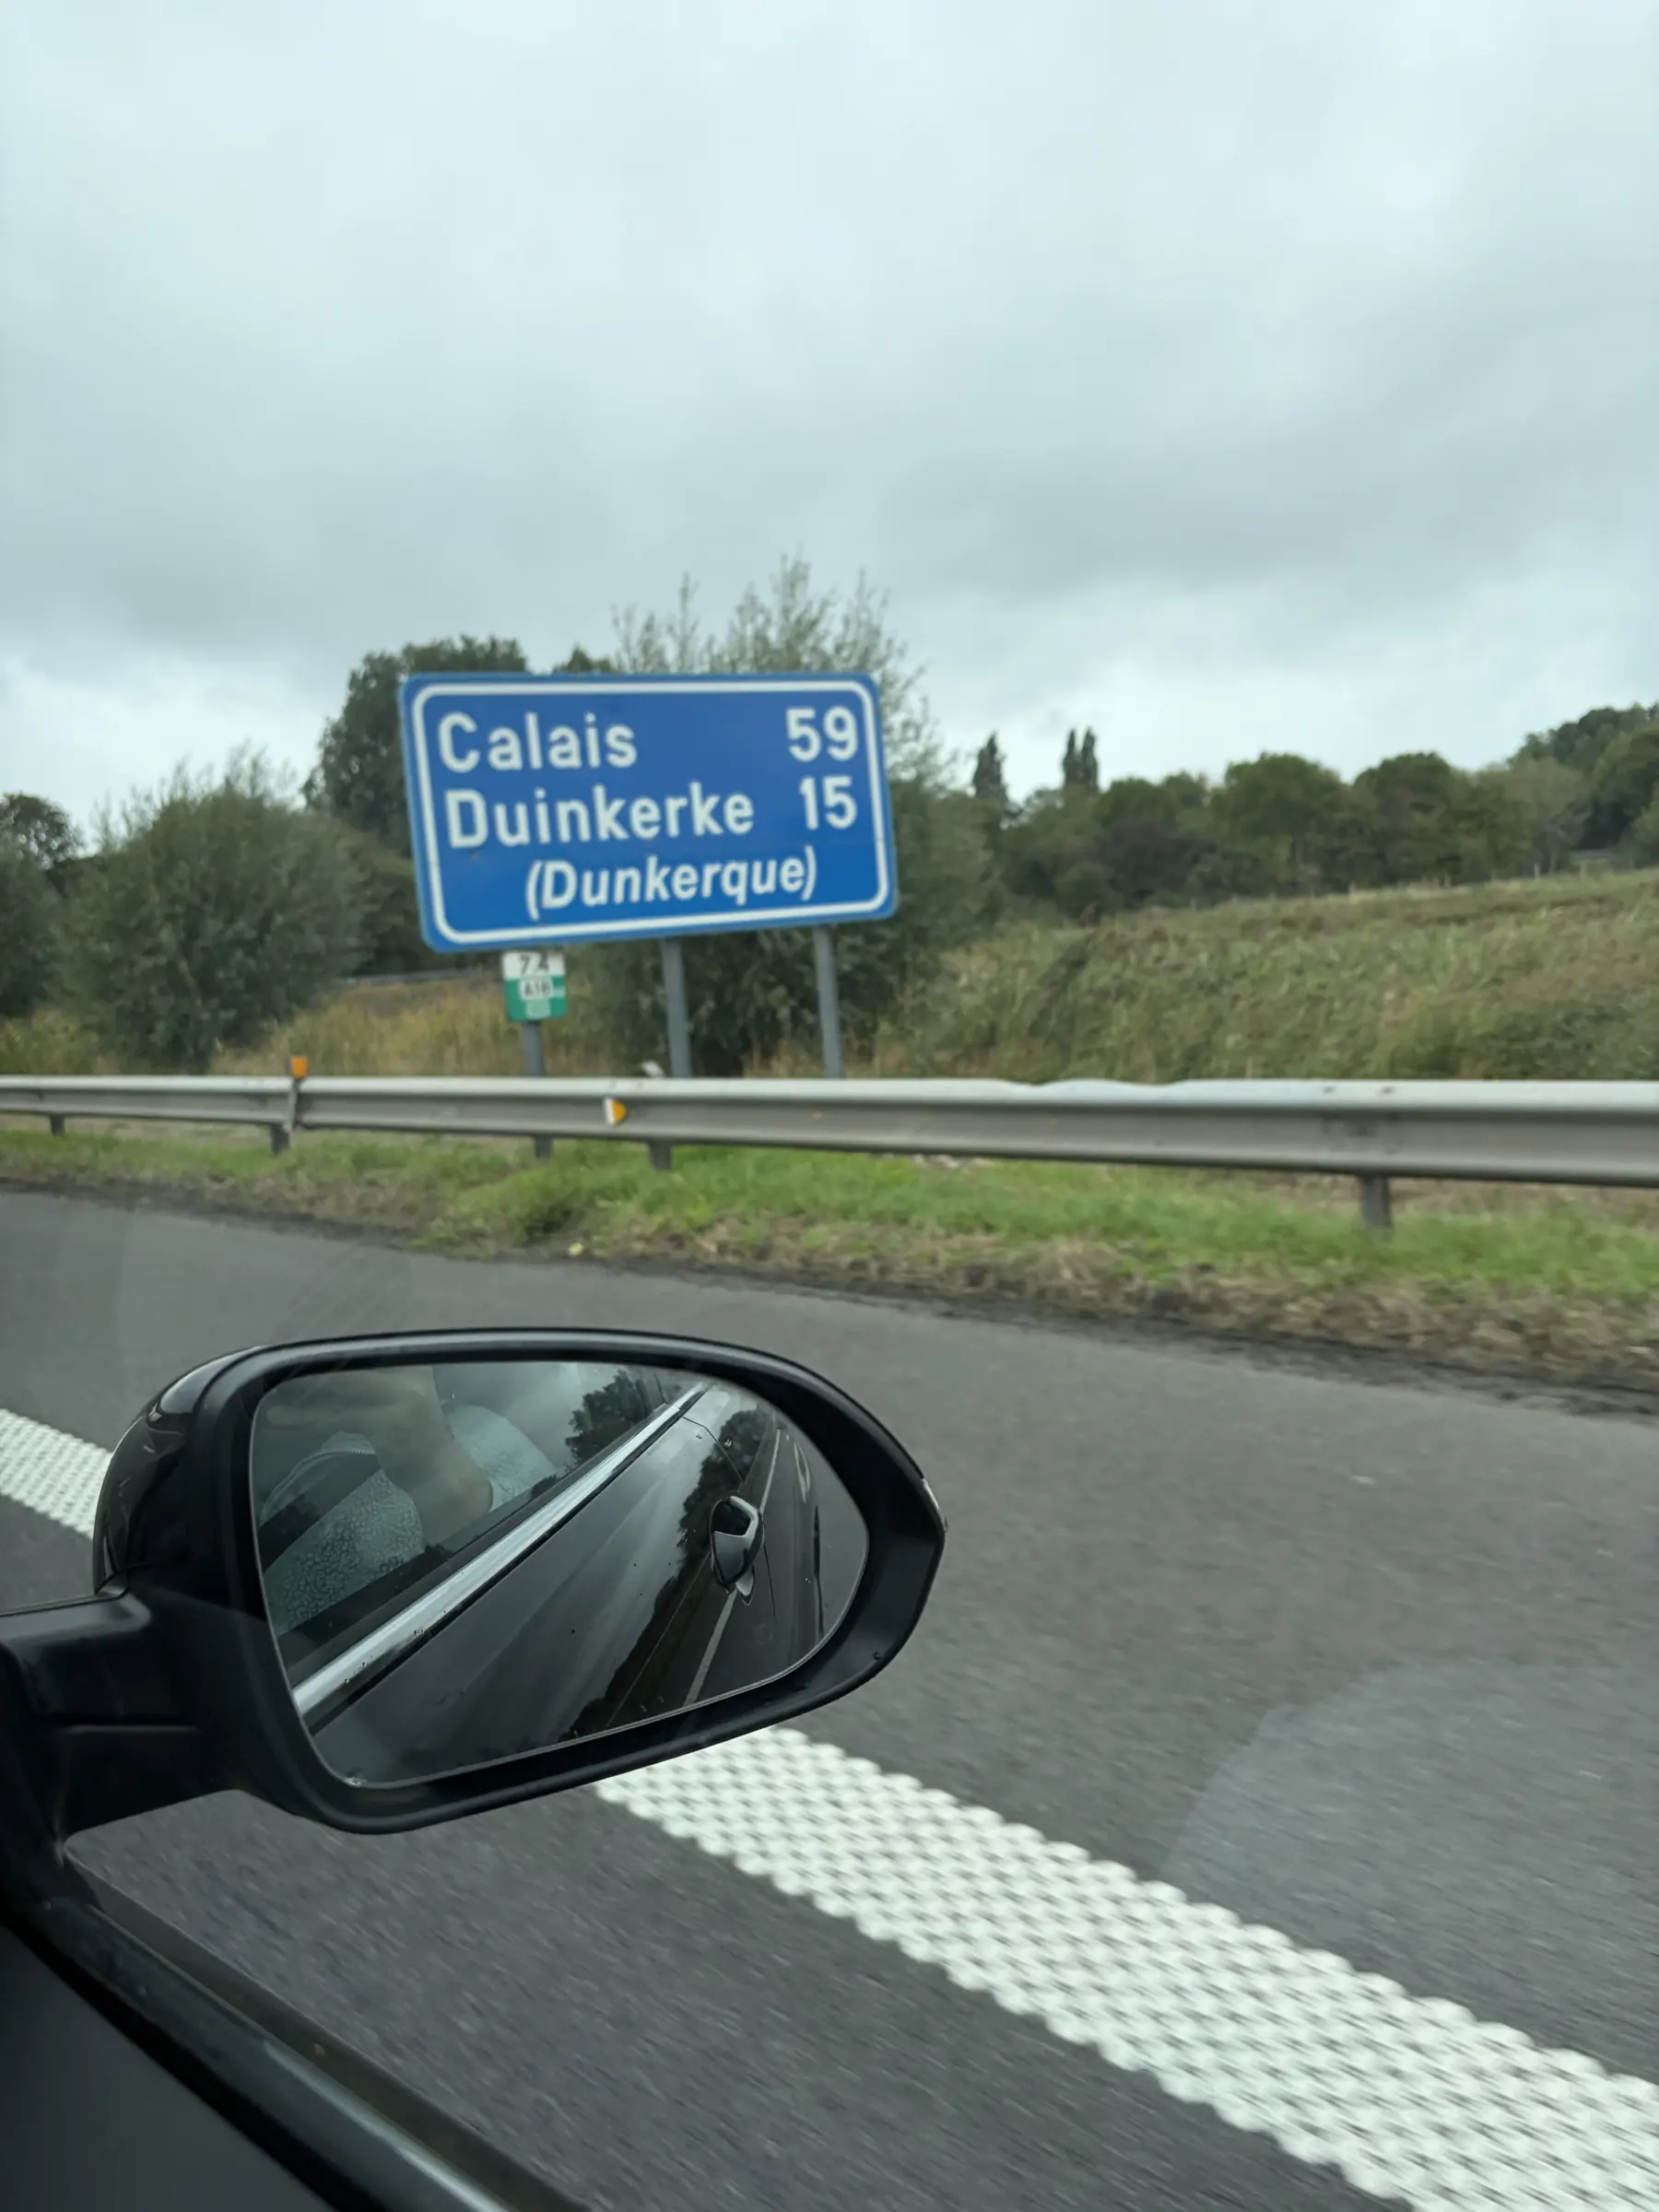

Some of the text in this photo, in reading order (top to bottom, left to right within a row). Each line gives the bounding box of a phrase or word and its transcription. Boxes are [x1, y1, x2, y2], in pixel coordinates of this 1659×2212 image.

[438, 706, 859, 772] Calais 59
[444, 775, 857, 849] Duinkerke 15
[525, 845, 817, 920] (Dunkerque)
